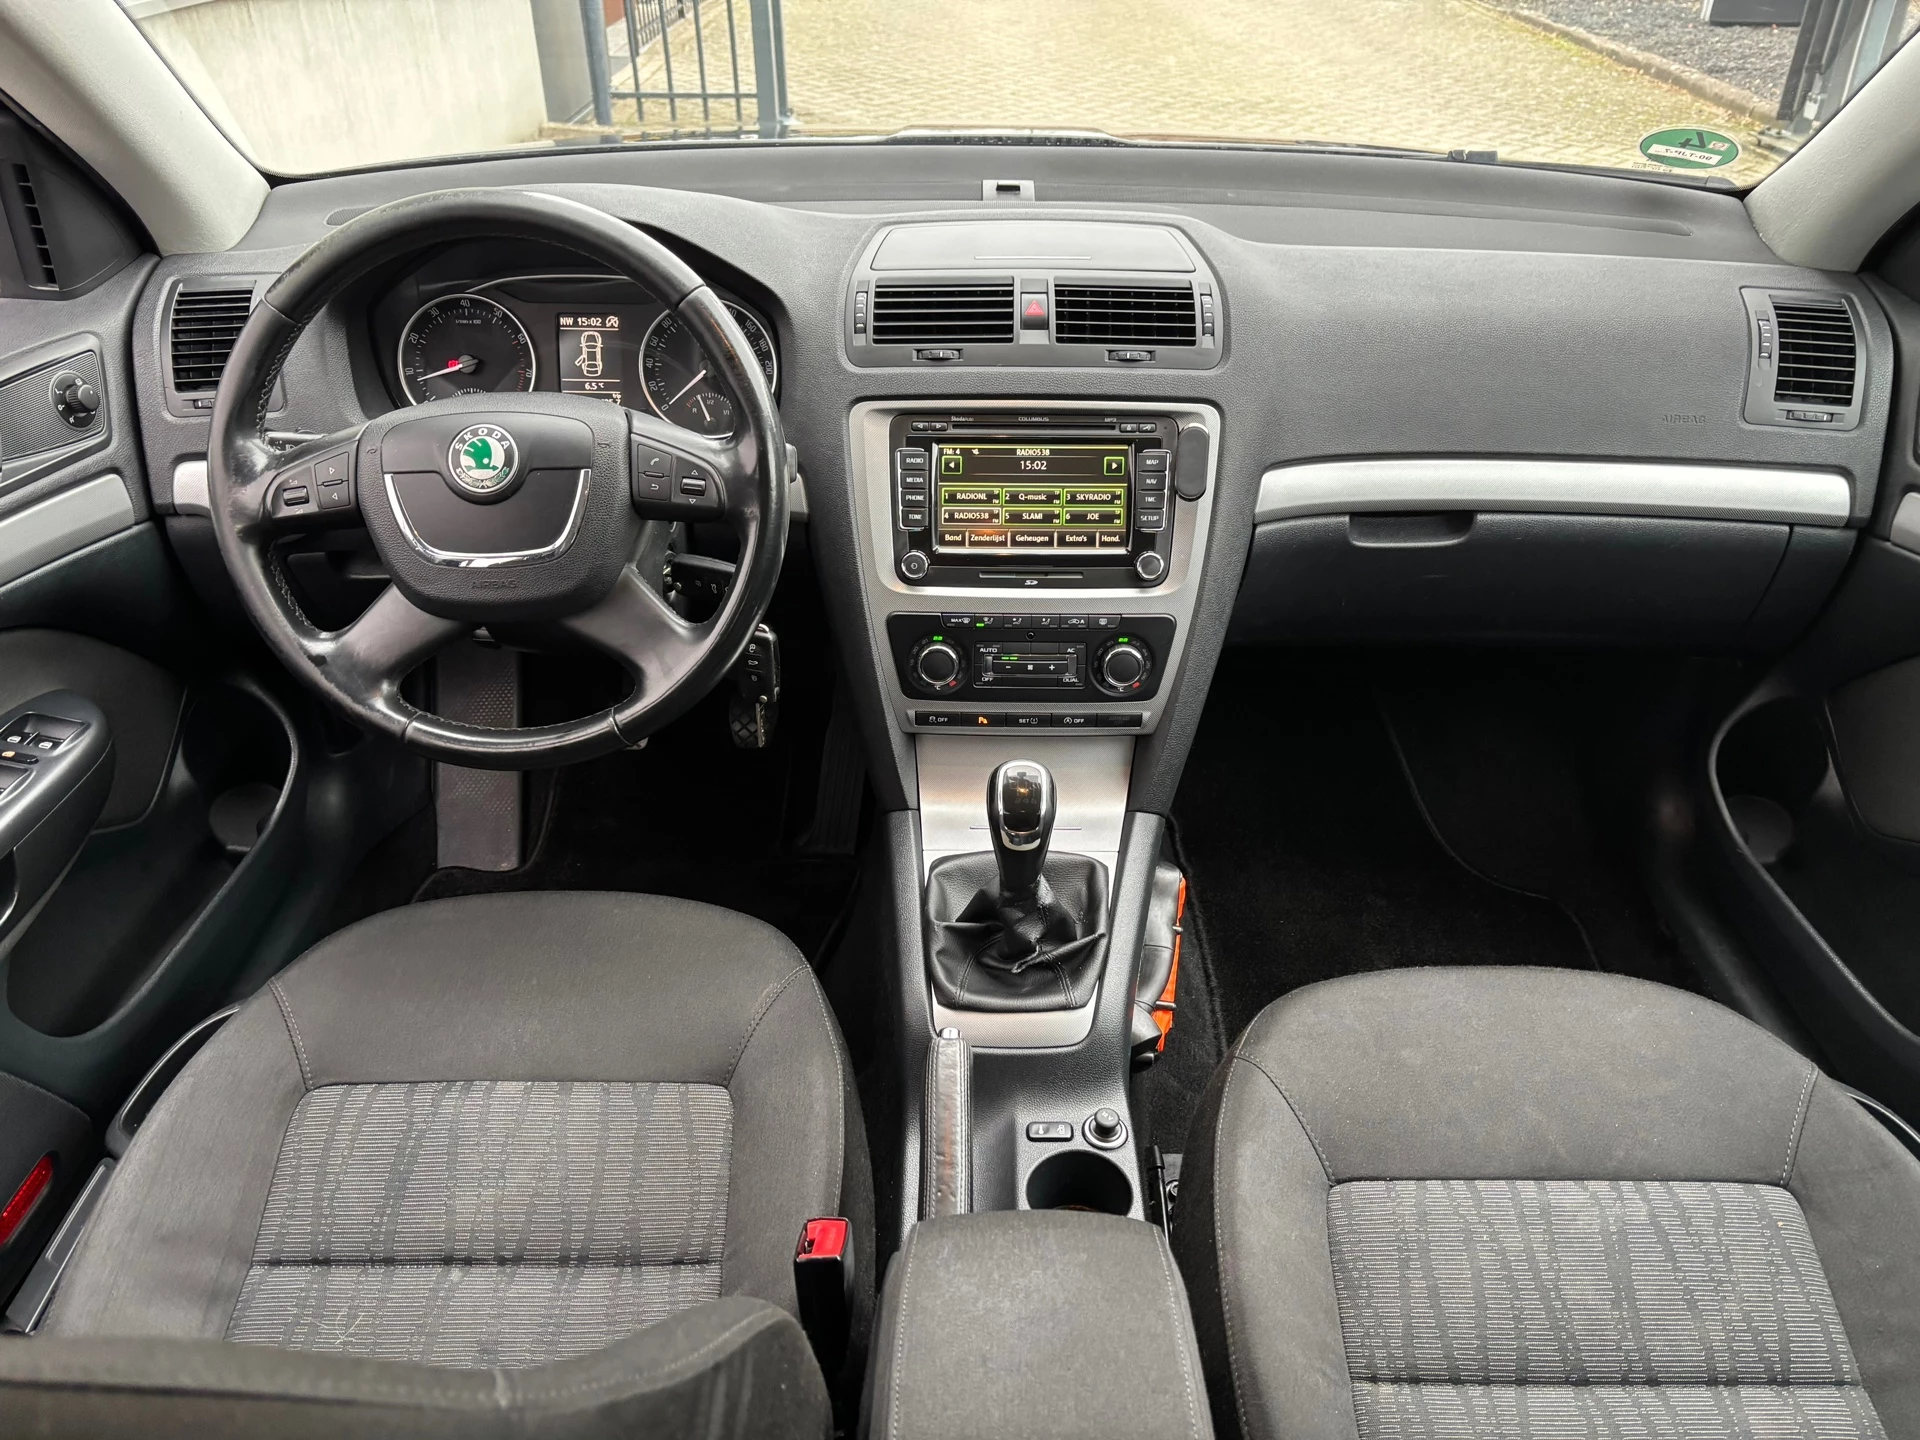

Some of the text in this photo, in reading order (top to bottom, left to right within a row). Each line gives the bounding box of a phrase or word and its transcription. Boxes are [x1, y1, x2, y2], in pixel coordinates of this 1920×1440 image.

[460, 300, 470, 308] 40
[428, 306, 440, 318] 30
[494, 308, 503, 318] 50
[560, 318, 602, 326] NW 15:02
[661, 318, 672, 328] 80
[745, 320, 756, 332] 160
[408, 332, 419, 344] 20
[517, 333, 526, 344] 60
[650, 336, 659, 346] 60
[759, 338, 768, 352] 180
[646, 358, 654, 368] 40
[405, 367, 414, 376] 10
[526, 368, 532, 378] 70
[648, 381, 658, 391] 20
[1662, 414, 1706, 424] AIRBAG
[1020, 460, 1047, 470] 15:02
[970, 534, 1005, 542] Zenderlijst
[472, 580, 518, 588] AIRBAG
